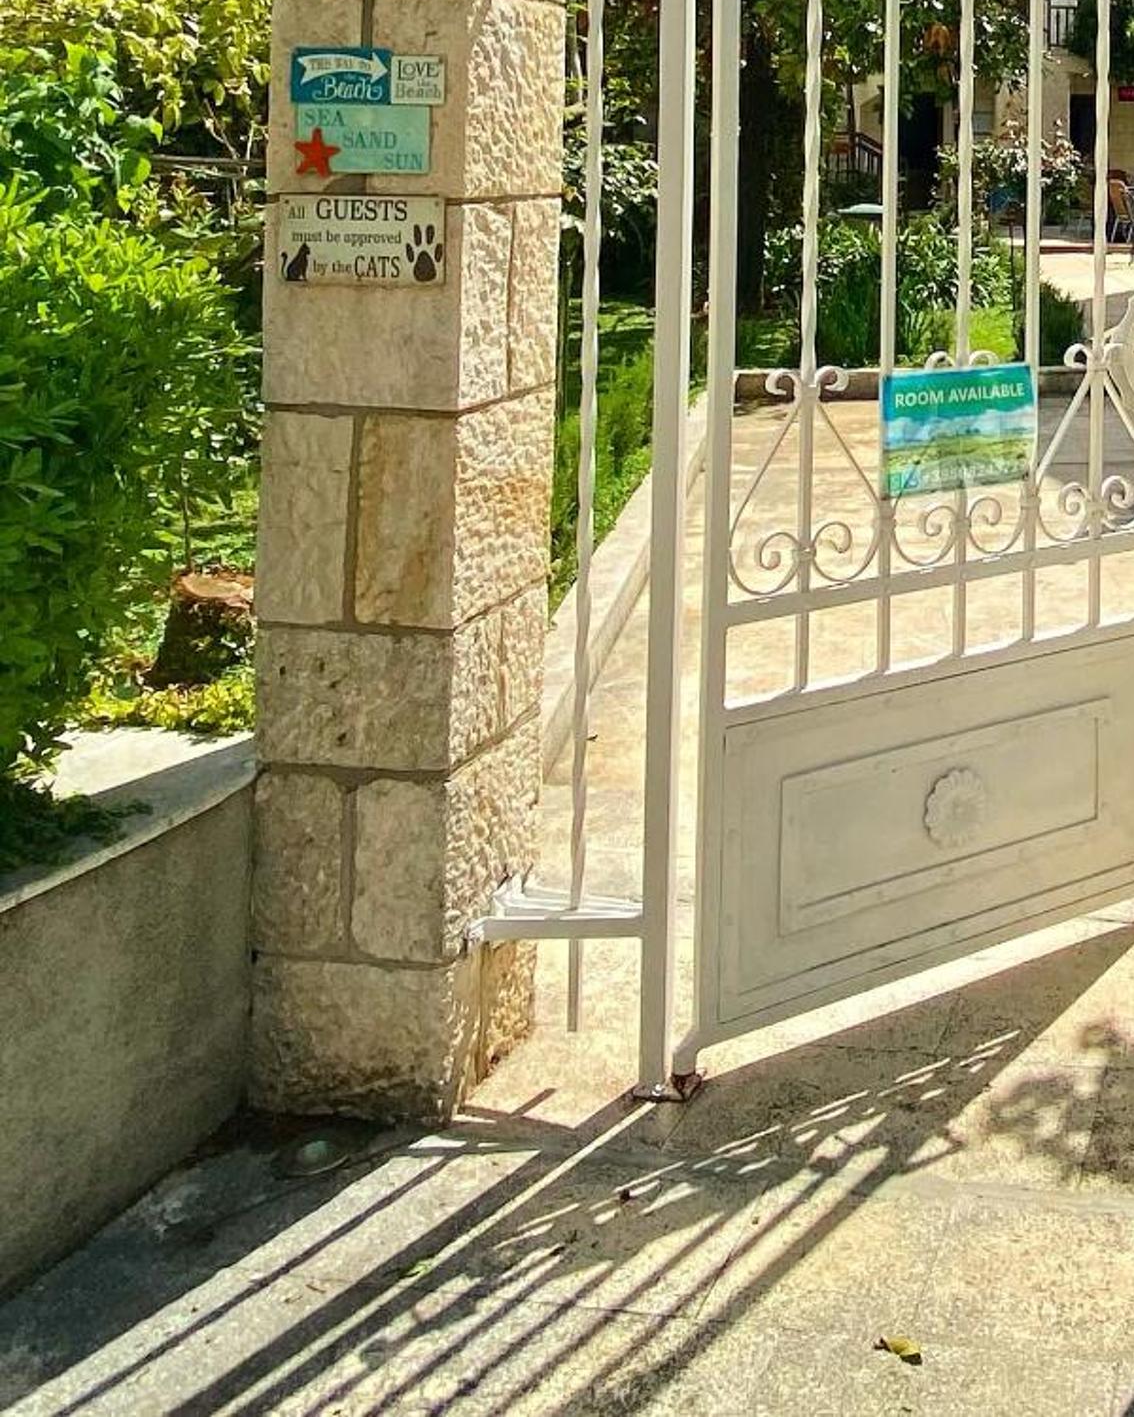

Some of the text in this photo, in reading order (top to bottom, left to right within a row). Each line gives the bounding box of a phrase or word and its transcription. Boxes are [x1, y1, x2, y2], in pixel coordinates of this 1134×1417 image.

[398, 59, 439, 81] LOVE
[312, 75, 383, 100] Beach
[396, 83, 441, 99] Beach
[304, 108, 345, 127] SEA
[343, 131, 397, 149] SAND
[384, 152, 423, 170] SUN
[288, 198, 408, 221] All GUESTS
[292, 230, 402, 246] must be approved
[313, 256, 401, 279] by the CATS
[895, 382, 1026, 408] ROOM AVAILABLE
